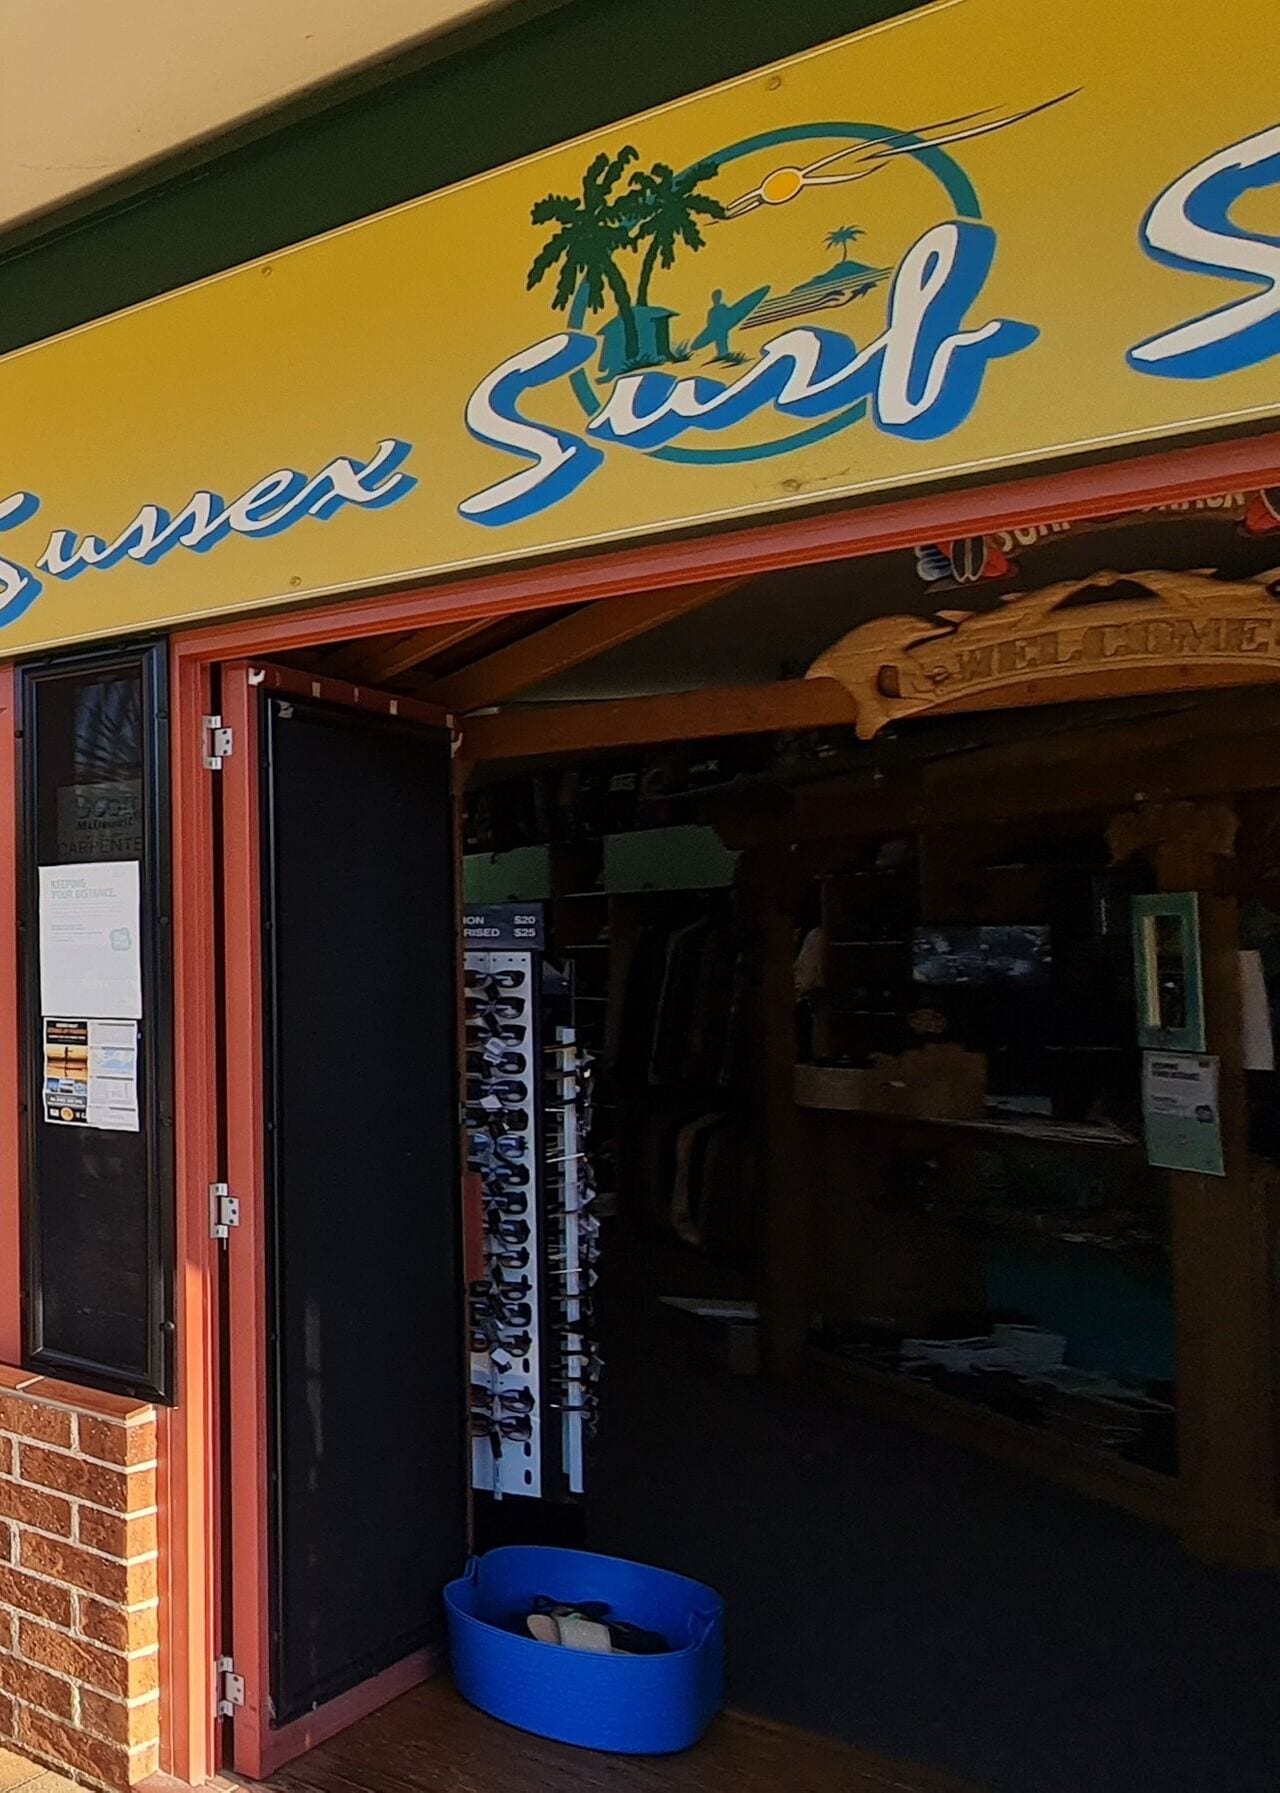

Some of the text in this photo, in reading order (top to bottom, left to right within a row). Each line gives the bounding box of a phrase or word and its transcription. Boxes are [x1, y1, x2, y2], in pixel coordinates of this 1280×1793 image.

[458, 220, 1039, 529] Surf
[958, 617, 1272, 683] WELCOME
[513, 915, 536, 924] $20
[513, 927, 536, 937] $25
